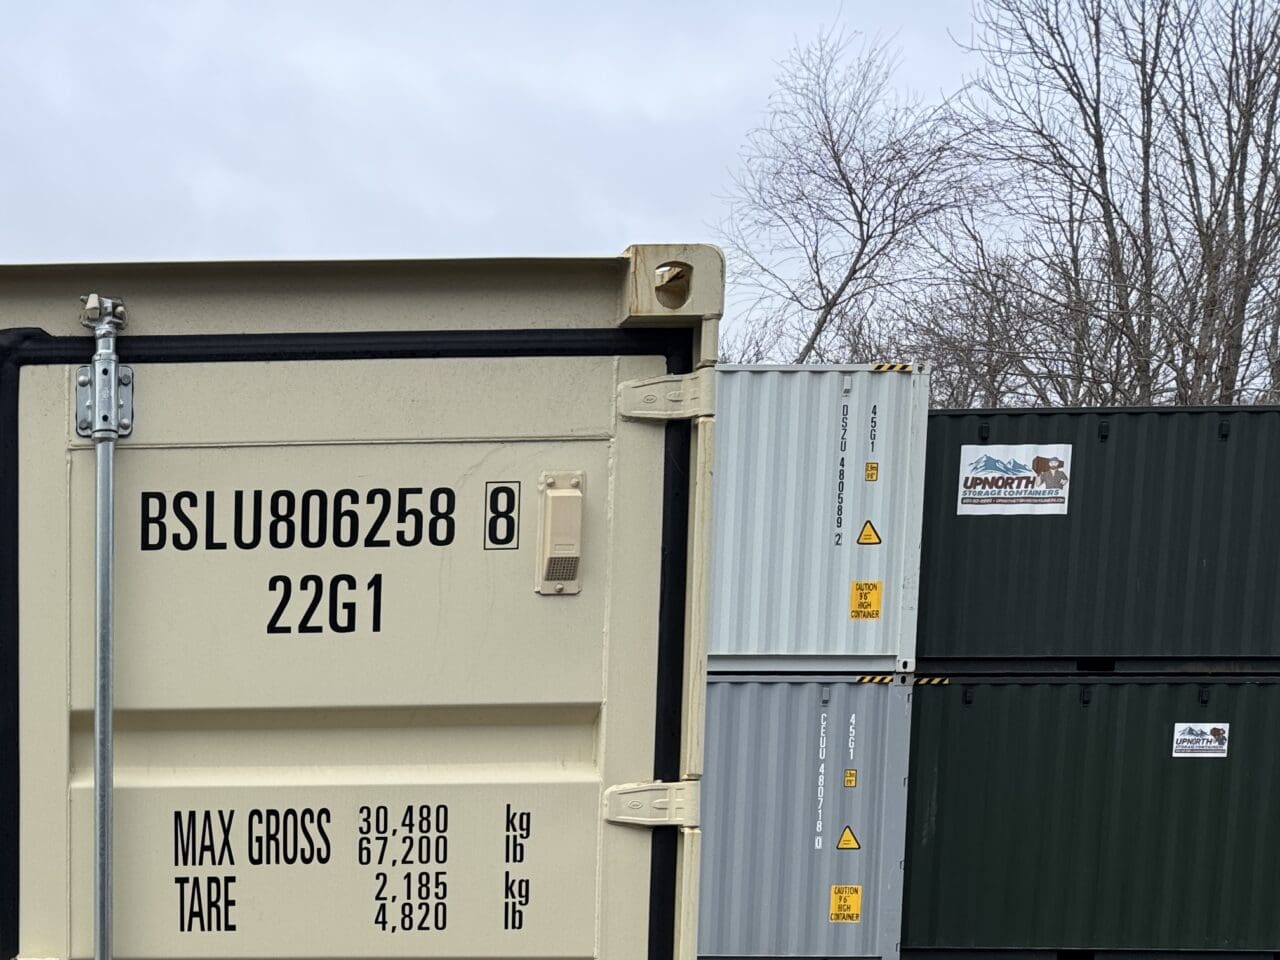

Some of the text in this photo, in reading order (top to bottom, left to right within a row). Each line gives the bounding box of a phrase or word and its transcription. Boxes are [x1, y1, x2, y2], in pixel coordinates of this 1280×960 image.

[963, 476, 1036, 489] UPNORTH
[141, 486, 515, 551] BSLU806258 8
[835, 534, 842, 546] 2
[856, 583, 877, 591] CAUTION
[267, 574, 382, 634] 22G1
[851, 610, 879, 618] CONTAINER
[848, 714, 856, 760] 45G1
[174, 804, 531, 866] MAX GROSS 30,480 kg
[358, 834, 524, 867] 67,200 lb
[175, 871, 529, 932] TARE 2,185 kg
[374, 902, 523, 933] 4,820 lb
[831, 913, 859, 921] CONTAINER
